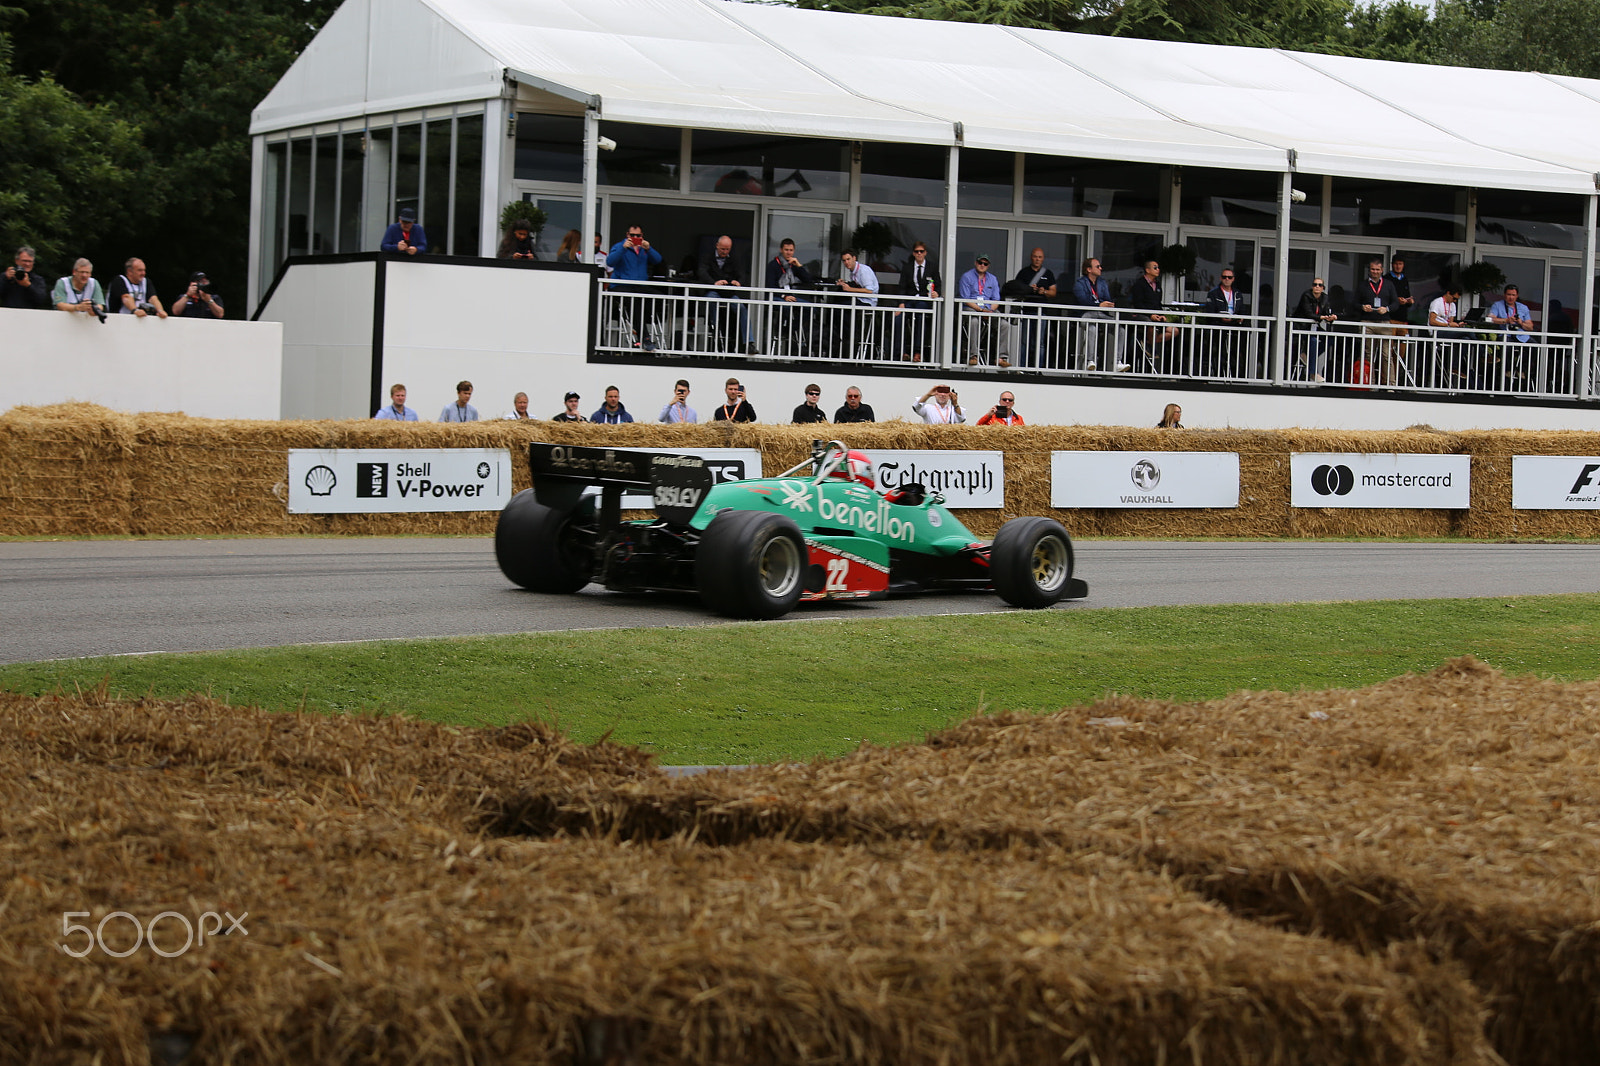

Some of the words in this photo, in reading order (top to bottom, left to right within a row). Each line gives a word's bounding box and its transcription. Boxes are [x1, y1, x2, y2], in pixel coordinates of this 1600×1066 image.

[371, 464, 383, 496] NEW
[396, 462, 431, 477] Shell
[878, 462, 993, 495] Telegraph
[1362, 472, 1452, 487] mastercard
[396, 479, 485, 498] V-Power
[654, 485, 702, 508] SISLEY
[1120, 495, 1174, 504] VAUXHALL
[817, 484, 915, 543] benetton
[826, 558, 850, 591] 22
